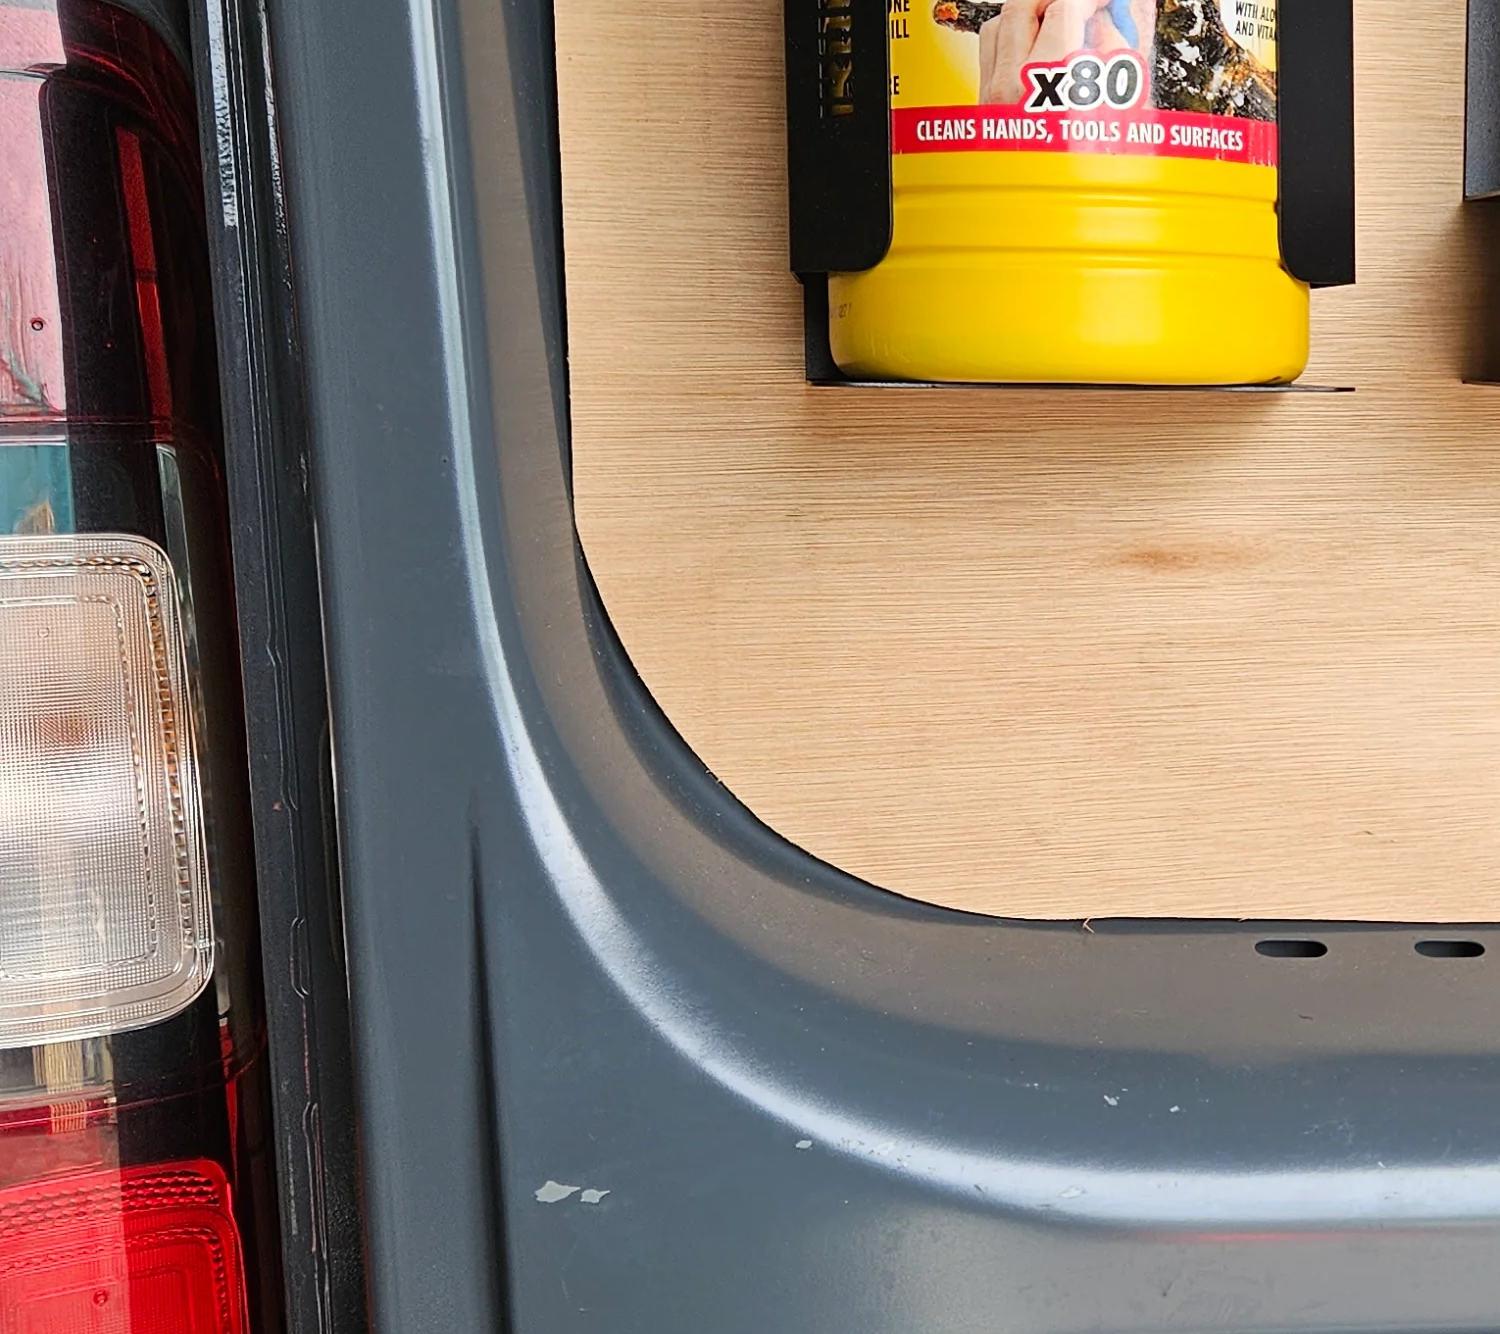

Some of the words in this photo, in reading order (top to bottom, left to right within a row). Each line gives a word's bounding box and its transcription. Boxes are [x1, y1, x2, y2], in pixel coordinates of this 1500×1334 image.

[1235, 0, 1258, 16] WITH
[1260, 6, 1276, 22] ALO
[891, 19, 909, 39] ILL
[1235, 20, 1255, 36] AND
[1257, 26, 1276, 42] VITA
[1029, 58, 1142, 110] x80
[916, 119, 976, 143] CLEANS
[982, 119, 1054, 144] HANDS,
[1061, 122, 1120, 144] TOOLS
[1127, 123, 1165, 146] AND
[1170, 126, 1244, 152] SURFACES
